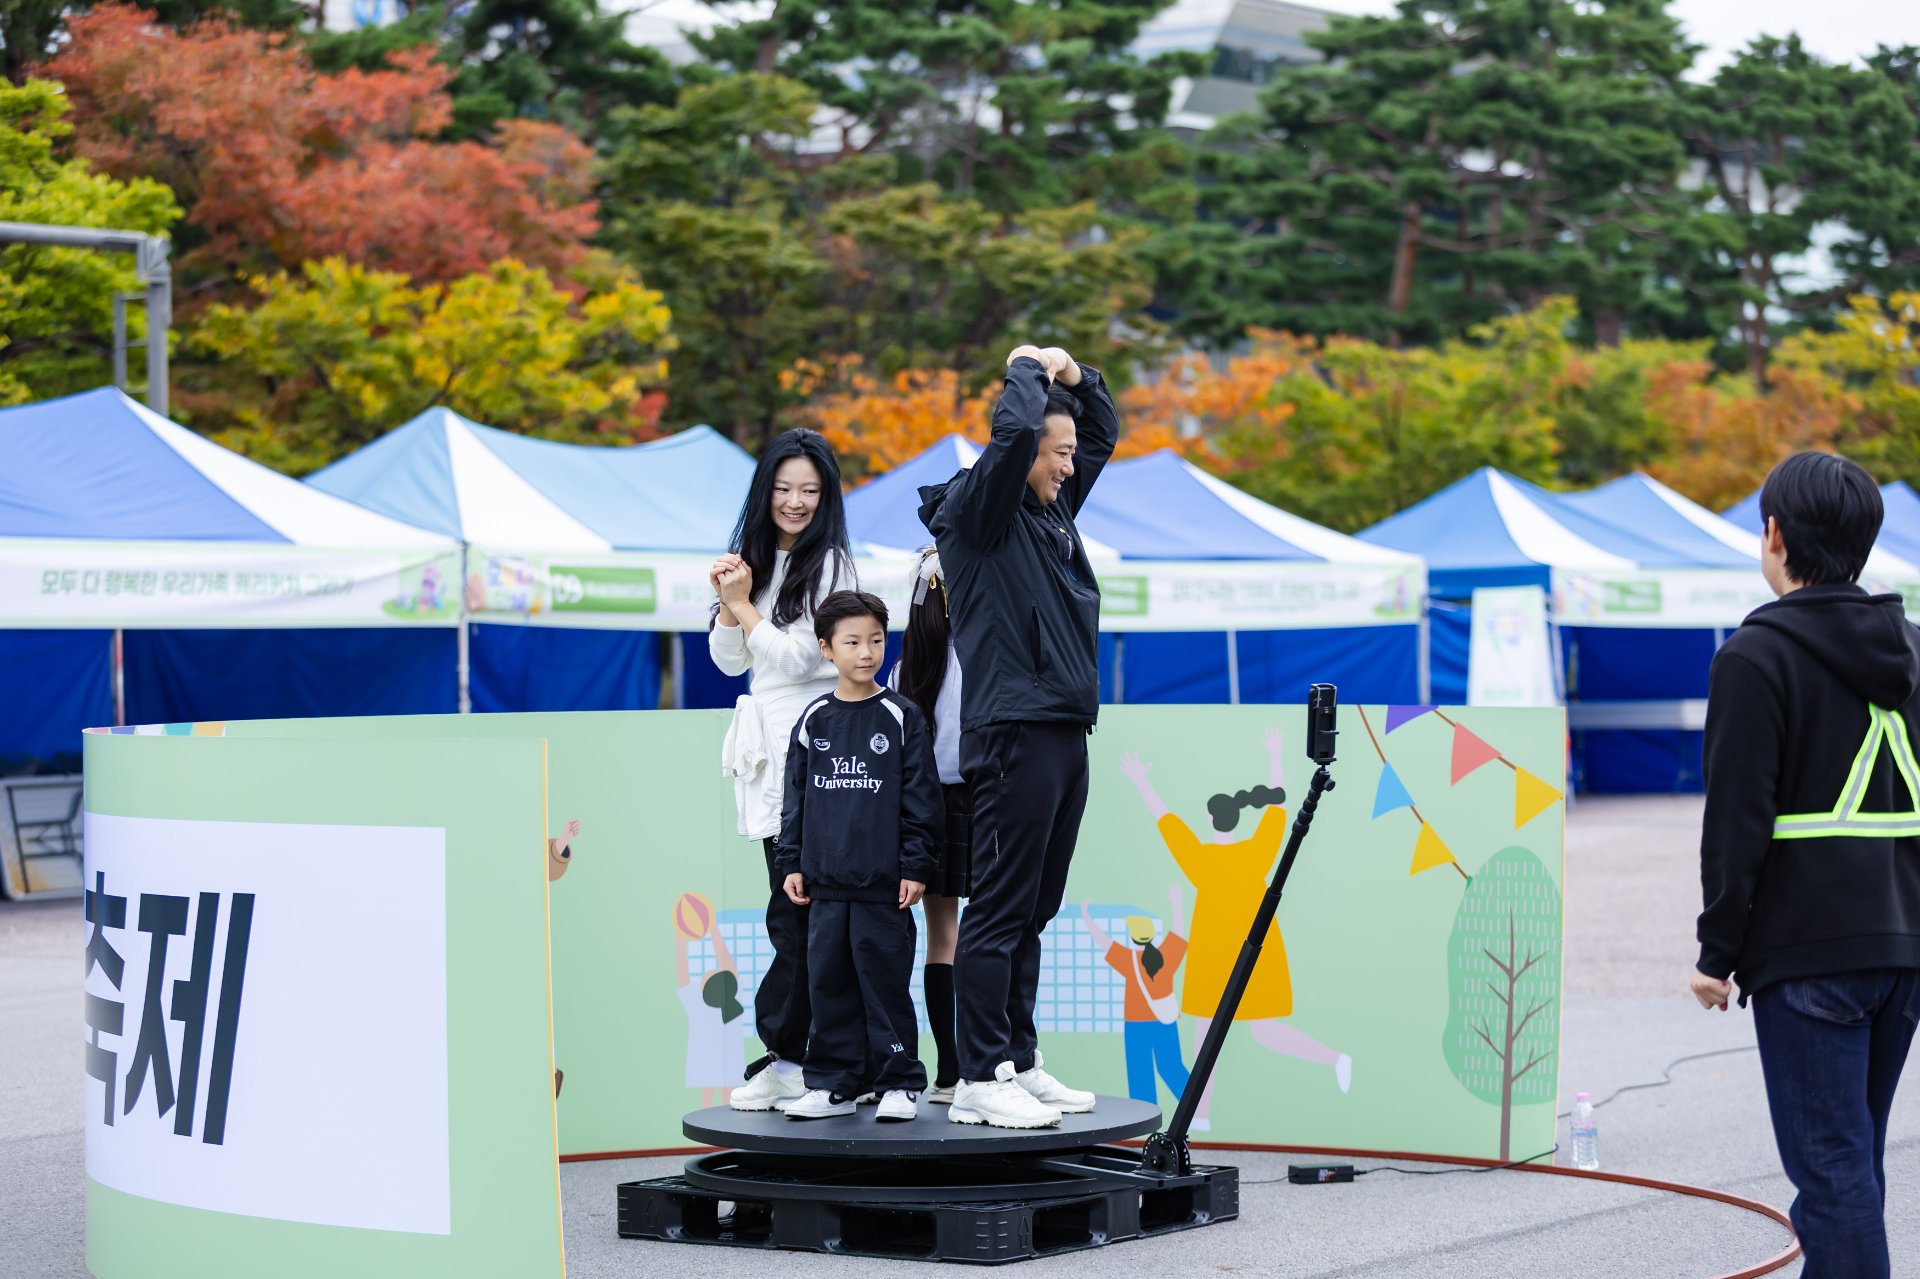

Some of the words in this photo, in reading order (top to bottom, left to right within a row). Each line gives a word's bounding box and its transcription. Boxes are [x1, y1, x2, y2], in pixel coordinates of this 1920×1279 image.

[40, 569, 78, 596] 모두
[81, 569, 100, 595] 다
[104, 569, 158, 597] 행복한
[814, 774, 883, 793] University
[85, 871, 256, 1146] 축제
